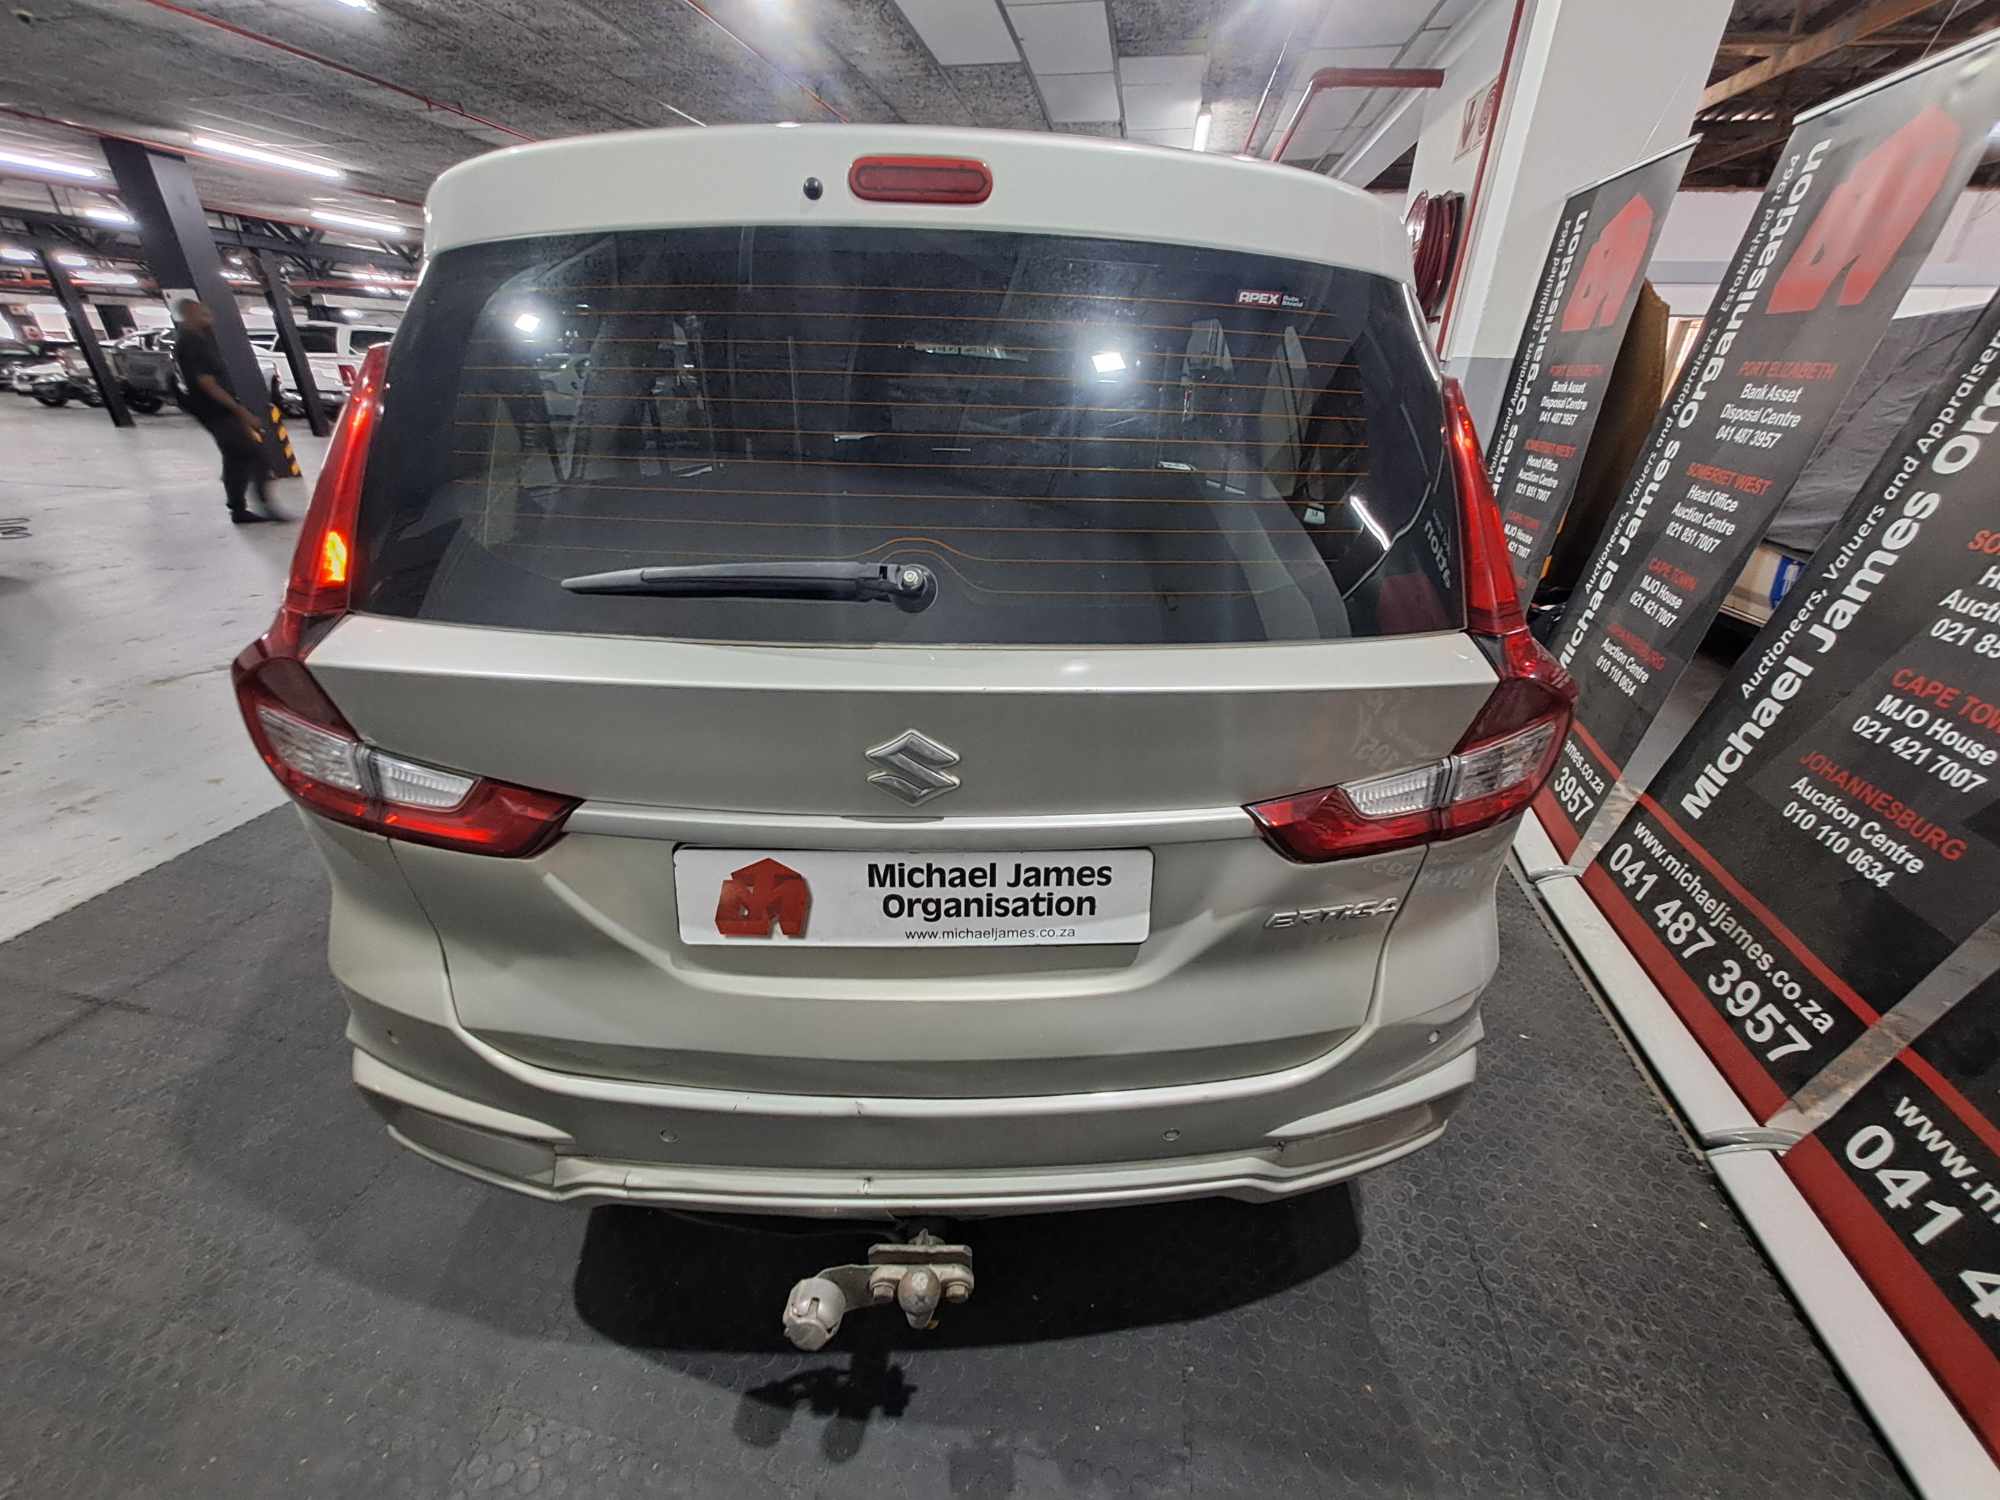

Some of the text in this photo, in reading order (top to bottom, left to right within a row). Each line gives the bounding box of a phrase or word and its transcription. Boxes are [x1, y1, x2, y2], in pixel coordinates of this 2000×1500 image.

[1238, 291, 1280, 305] APEX
[1502, 407, 1514, 432] and
[1509, 341, 1535, 408] Appraisers
[1532, 257, 1561, 332] Established
[1556, 219, 1572, 253] 1964
[1620, 439, 1681, 556] James
[1678, 138, 1833, 429] Organisation
[1492, 424, 1518, 497] mes
[1515, 209, 1590, 417] Organisation
[1584, 511, 1629, 595] Auctioneers,
[1626, 449, 1658, 506] Valuers
[1655, 416, 1674, 449] and
[1672, 328, 1718, 416] Appraisers
[1720, 207, 1776, 313] Established
[1771, 152, 1801, 203] 1964
[1565, 398, 1588, 412] Centre
[1720, 402, 1802, 428] Disposal Centre
[1740, 383, 1803, 404] Bank Asset
[1715, 425, 1783, 450] 041 487 3957
[1671, 501, 1737, 537] Auction Centre
[1686, 484, 1739, 513] Head Office
[1741, 588, 1830, 698] Auctioneers,
[1822, 504, 1887, 583] Valuers
[1883, 455, 1921, 500] and
[1916, 328, 2000, 454] Appraiser
[1664, 521, 1722, 554] 021 851 7007
[1629, 591, 1679, 628] 021 421 7007
[1639, 574, 1684, 610] MJO House
[1937, 588, 2000, 624] Aucti
[1680, 489, 1940, 820] Michael James
[1930, 618, 2000, 659] 021 85
[1596, 655, 1612, 674] 010
[1609, 664, 1624, 684] 110
[1600, 637, 1626, 666] Auction
[1624, 656, 1650, 685] Centre
[1891, 668, 2000, 736] CAPE TO
[1874, 694, 1998, 766] MJO House
[1851, 715, 1989, 793] 021 421 7007
[1554, 766, 1595, 822] 3957
[1800, 750, 1968, 862] JOHANNESBURG
[1782, 800, 1896, 889] 010 110 0634
[1790, 776, 1924, 875] Auction Centre
[867, 862, 1113, 889] Michael James
[881, 893, 1097, 923] Organisation
[1264, 897, 1399, 929] ERTIGA
[1633, 821, 1835, 1035] www.michaeljames.co.za
[904, 926, 1076, 941] www.michaeljames.co.za
[1609, 843, 1814, 1063] 041 487 3957
[1846, 1124, 1965, 1246] 041
